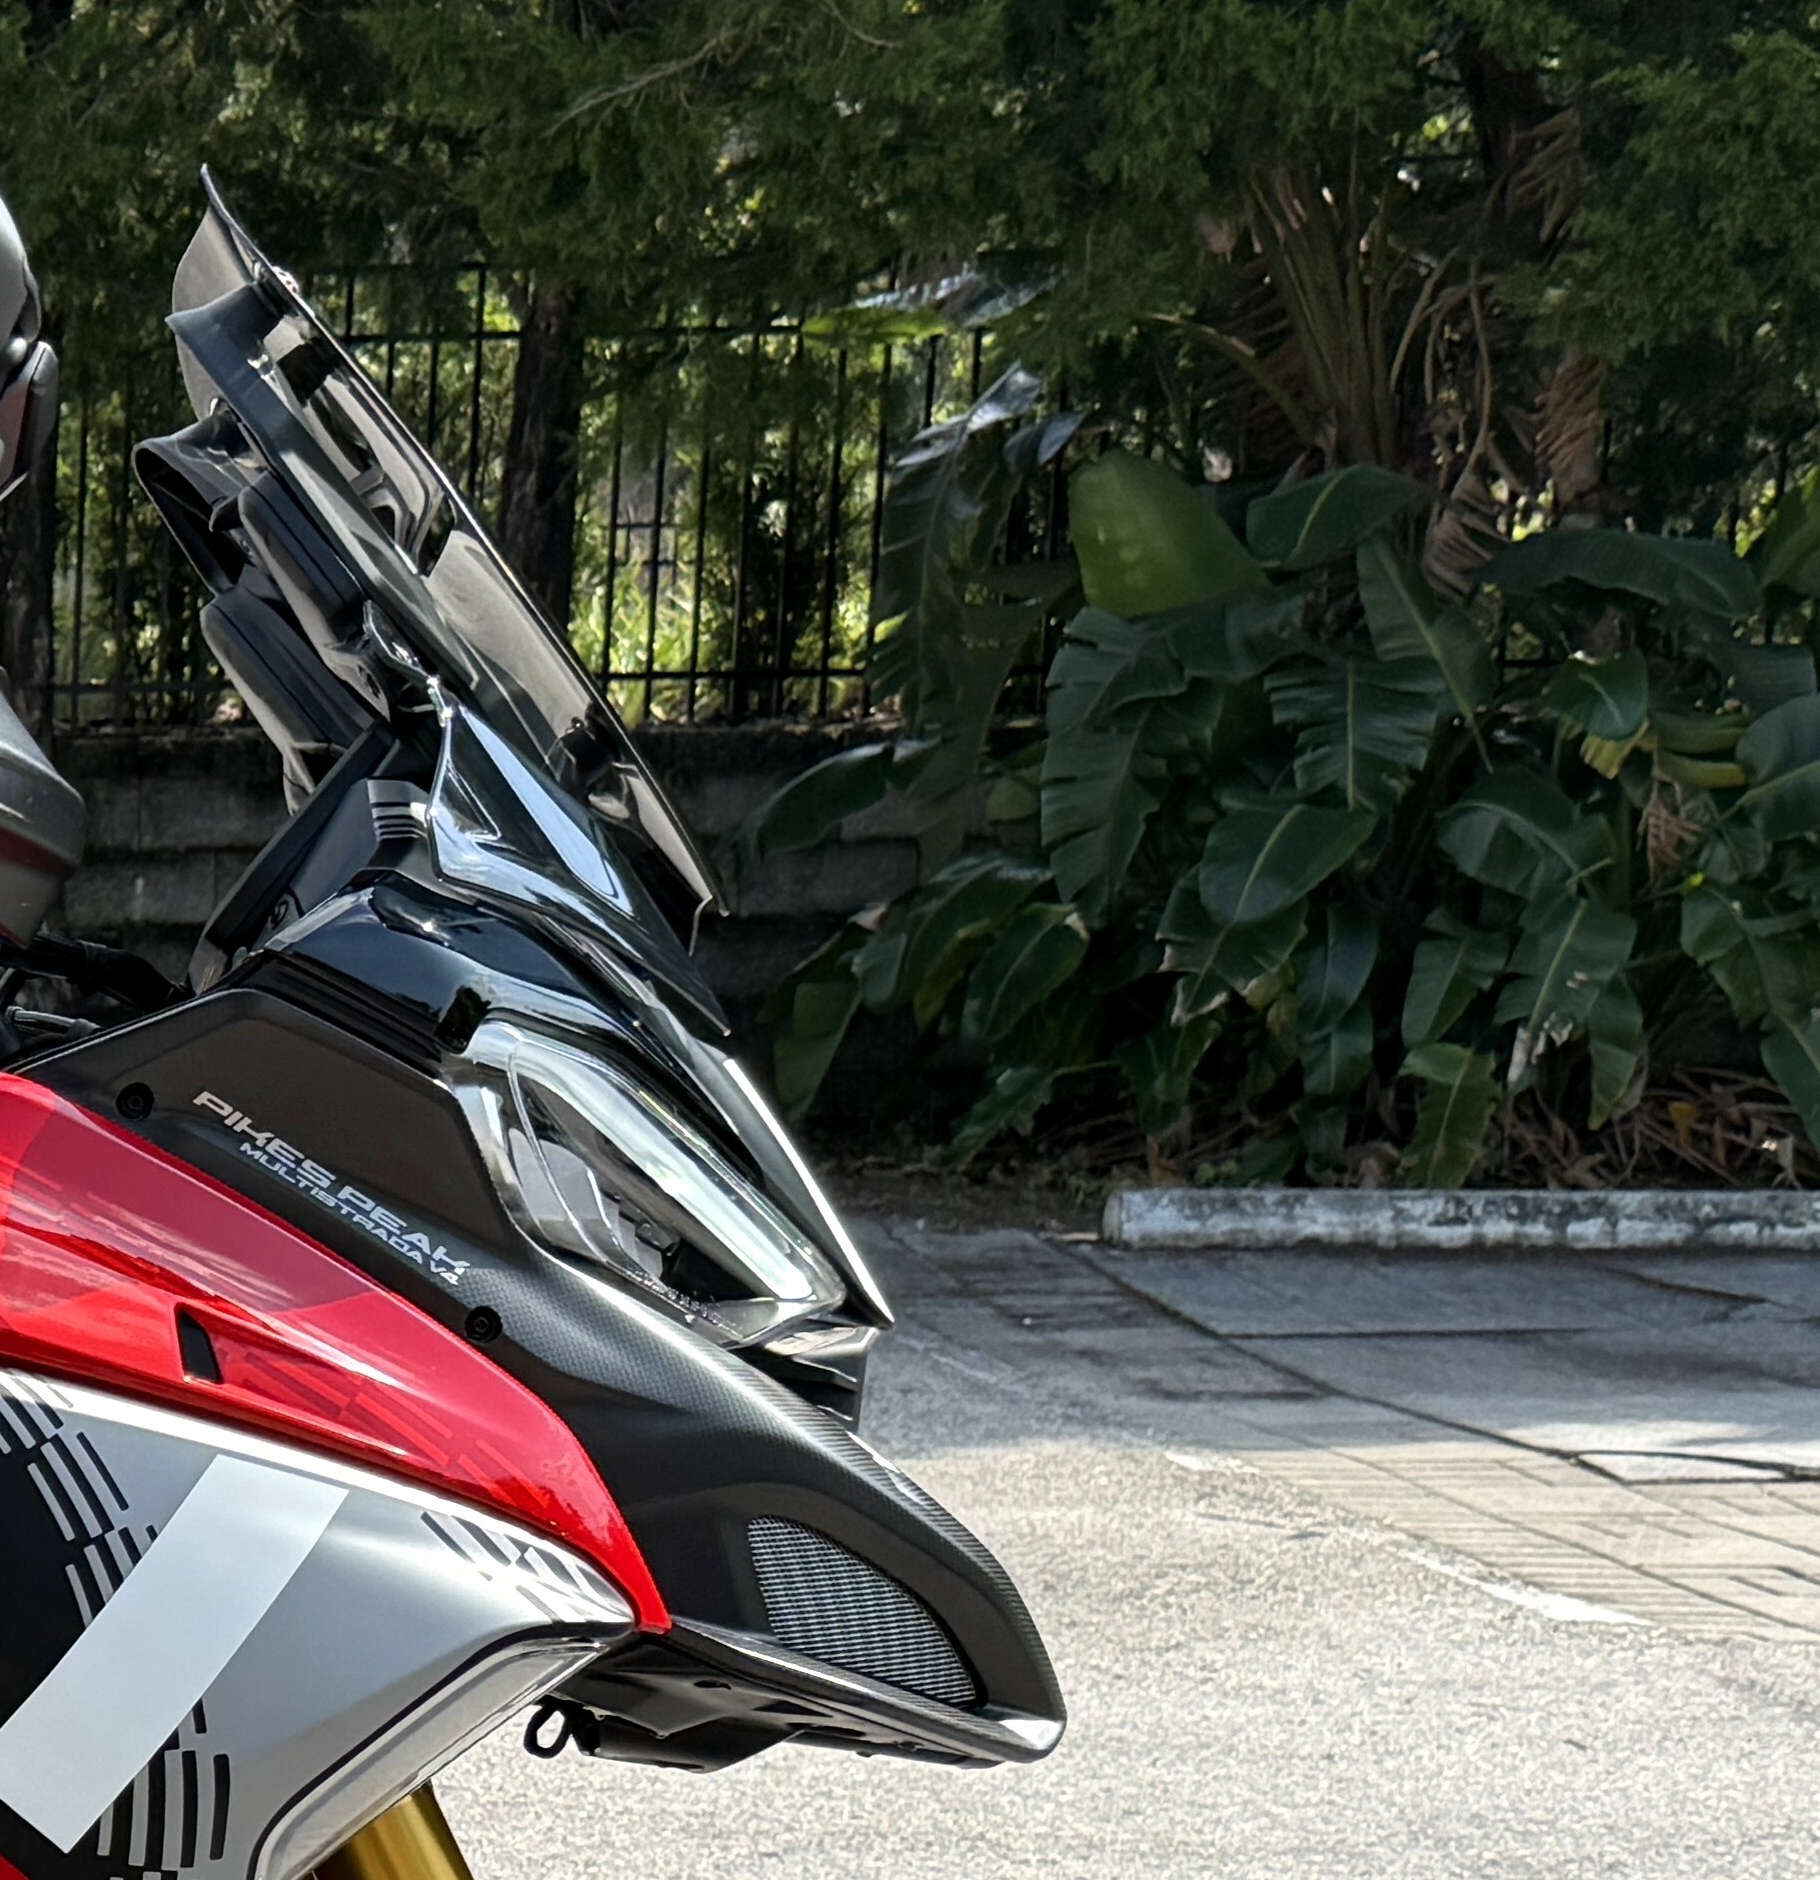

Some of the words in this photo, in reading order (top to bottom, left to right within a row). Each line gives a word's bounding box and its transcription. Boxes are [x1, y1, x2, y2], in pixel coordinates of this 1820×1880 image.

[192, 1091, 337, 1192] PIKES
[338, 1184, 471, 1277] PEAK
[239, 1141, 425, 1264] MULTISTRADA
[425, 1257, 467, 1287] V4
